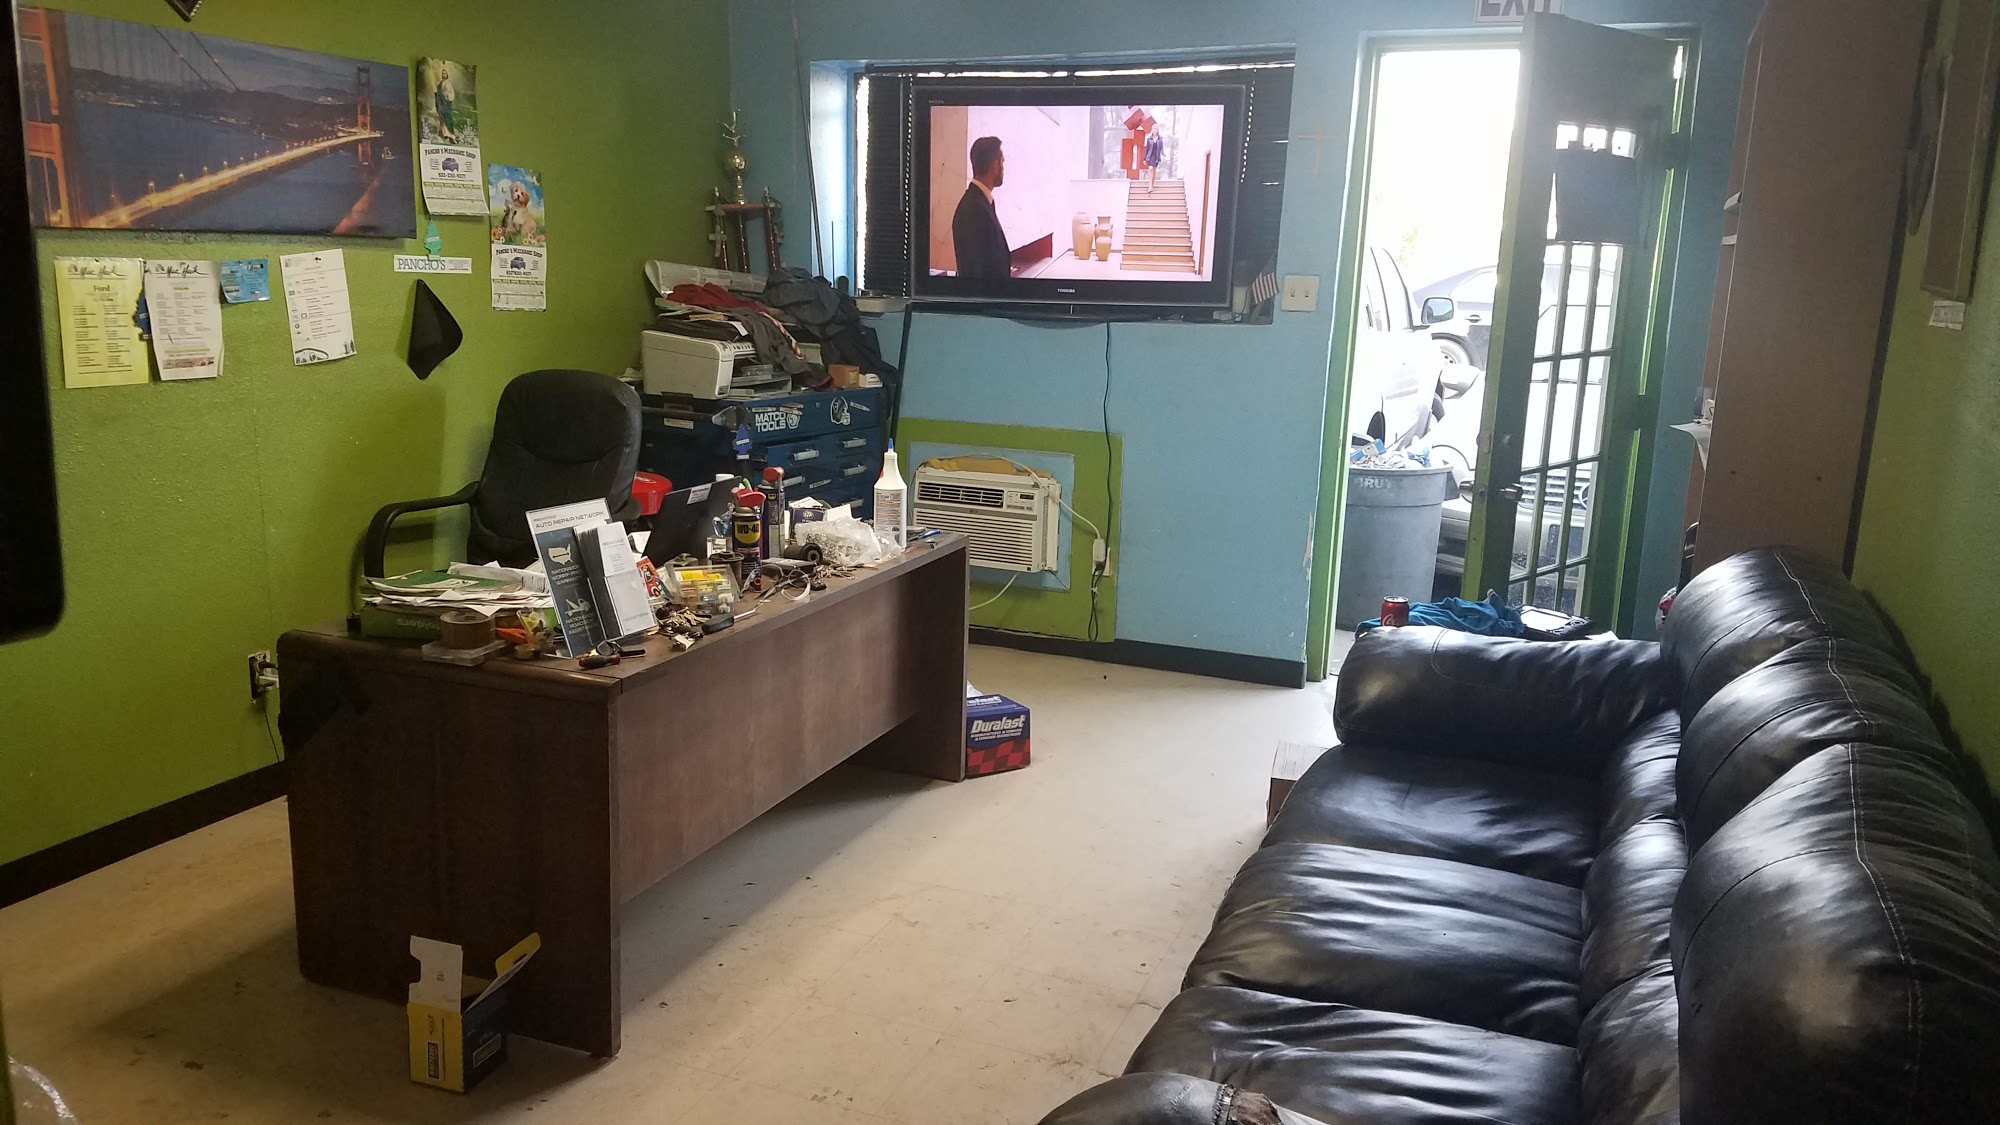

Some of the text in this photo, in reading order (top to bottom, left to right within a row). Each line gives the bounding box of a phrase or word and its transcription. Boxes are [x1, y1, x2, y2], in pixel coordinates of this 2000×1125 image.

[397, 258, 446, 271] PANCHO'S
[93, 284, 111, 292] Ford
[755, 411, 787, 423] MATCO
[755, 420, 787, 433] TOOLS
[535, 521, 553, 529] AUTO
[553, 516, 575, 525] REPAIR
[575, 511, 604, 521] NETWORK
[736, 523, 760, 535] WD-40
[970, 714, 1026, 734] Duralast
